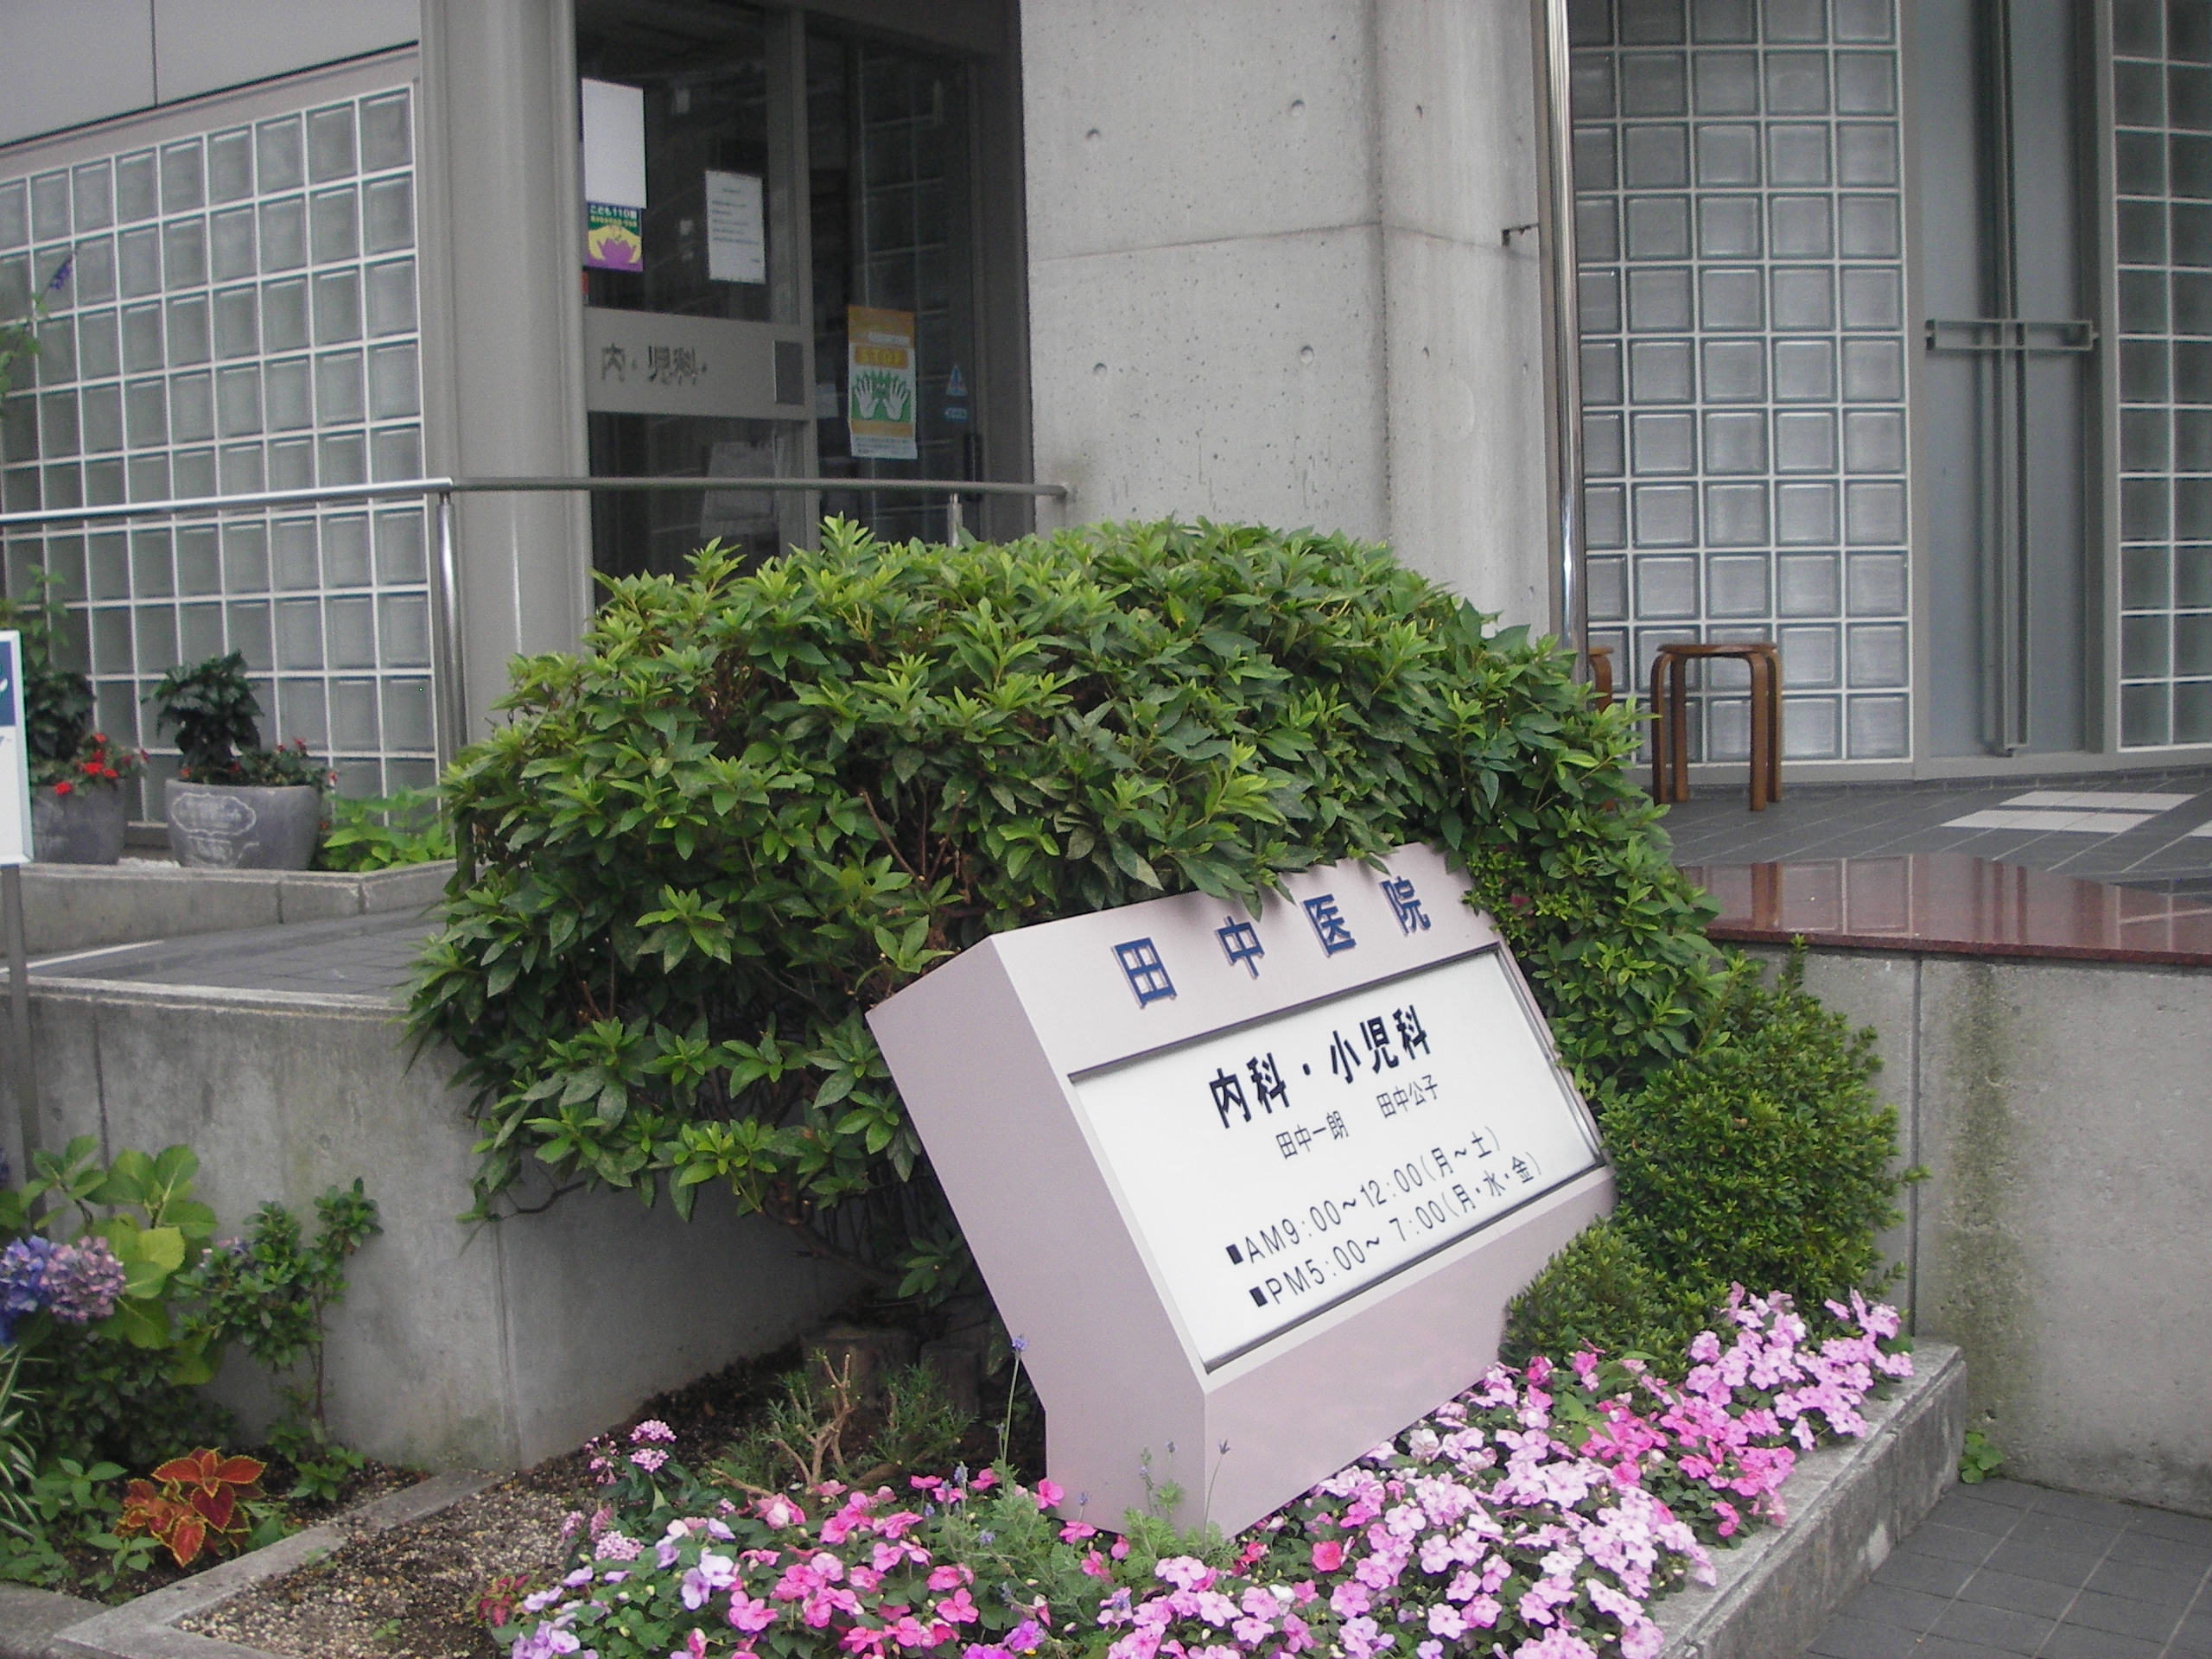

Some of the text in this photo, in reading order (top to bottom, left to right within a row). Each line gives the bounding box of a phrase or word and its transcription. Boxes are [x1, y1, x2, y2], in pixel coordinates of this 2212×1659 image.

[1111, 875, 1432, 1008] 田中医院
[1209, 1004, 1431, 1128] 内科・小児科
[1275, 1074, 1439, 1160] 田中一朗 田中公子
